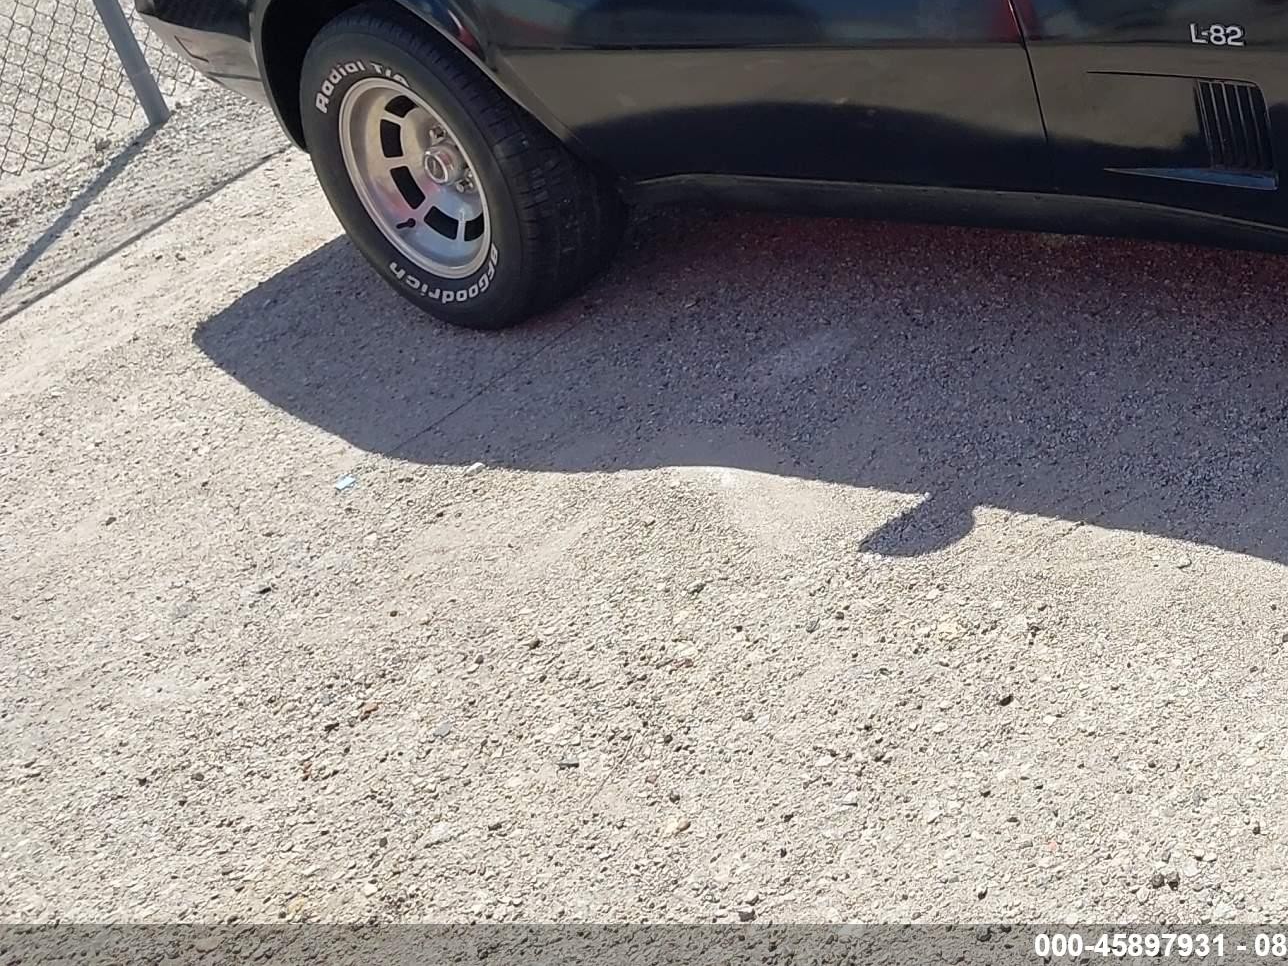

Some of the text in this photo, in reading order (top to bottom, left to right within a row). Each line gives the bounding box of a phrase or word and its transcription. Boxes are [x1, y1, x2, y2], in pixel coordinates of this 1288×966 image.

[1190, 23, 1244, 46] L-82
[315, 60, 366, 114] Radial
[390, 242, 501, 305] BFGoodrich
